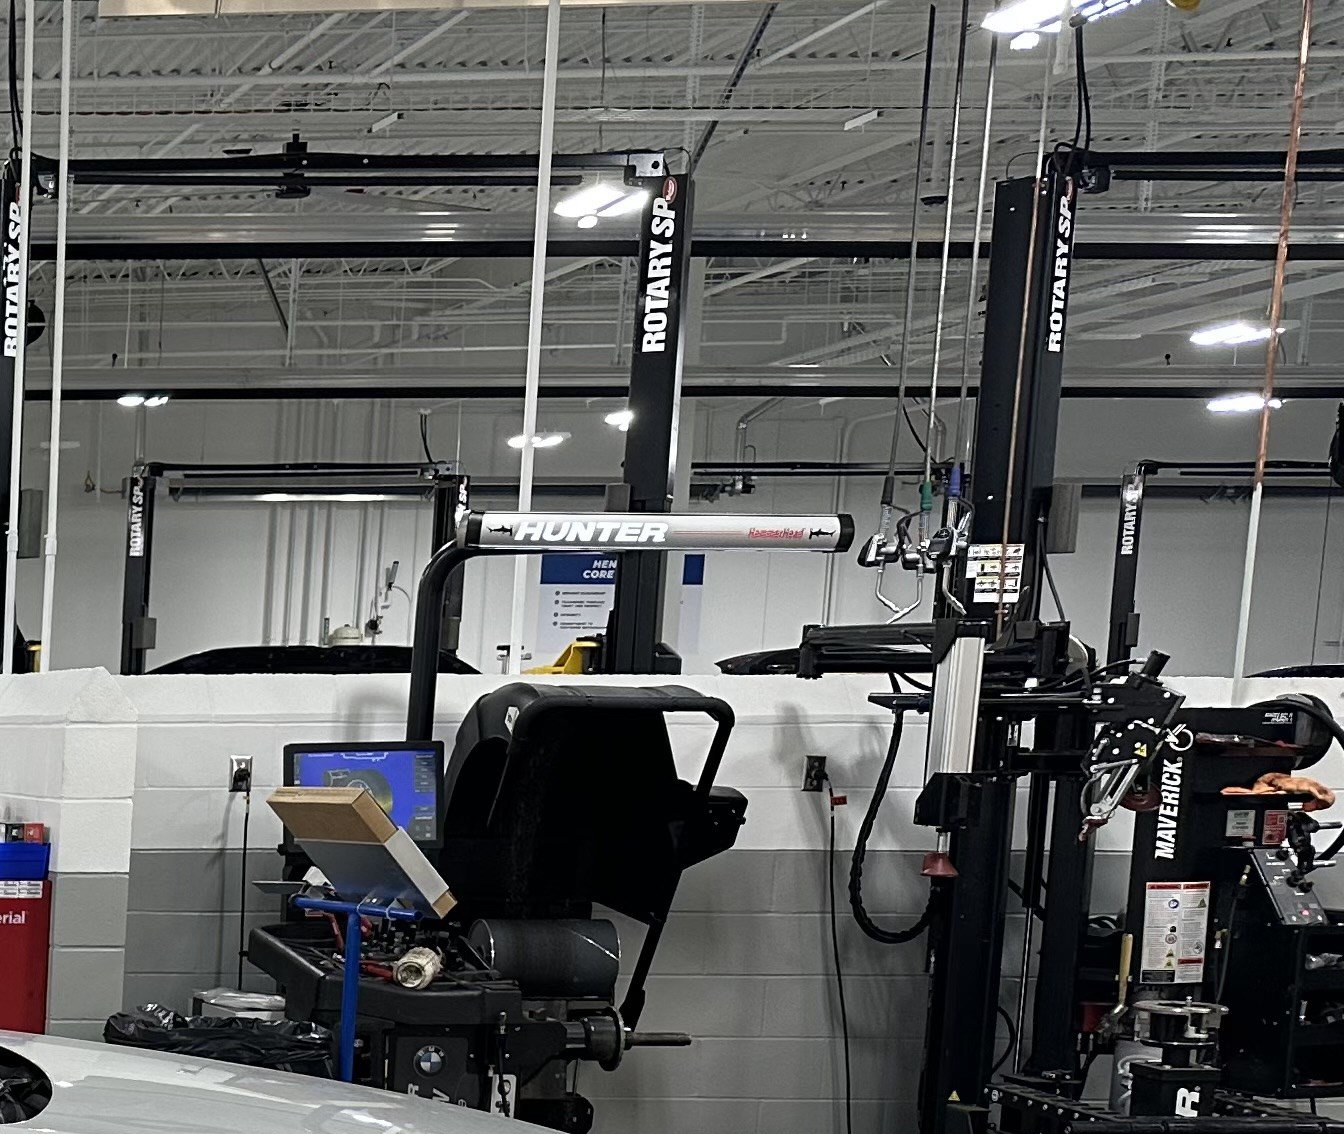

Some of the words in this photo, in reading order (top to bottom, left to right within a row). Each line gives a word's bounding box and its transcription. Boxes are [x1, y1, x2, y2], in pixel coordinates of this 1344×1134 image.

[651, 197, 676, 238] SP
[3, 243, 21, 358] ROTARY
[642, 240, 673, 352] ROTARY
[1048, 239, 1069, 352] ROTARY
[1059, 196, 1072, 238] SP
[514, 521, 669, 543] HUNTER
[1120, 503, 1137, 555] ROTARY
[582, 569, 615, 579] CORE
[1154, 759, 1183, 860] MAVERICK
